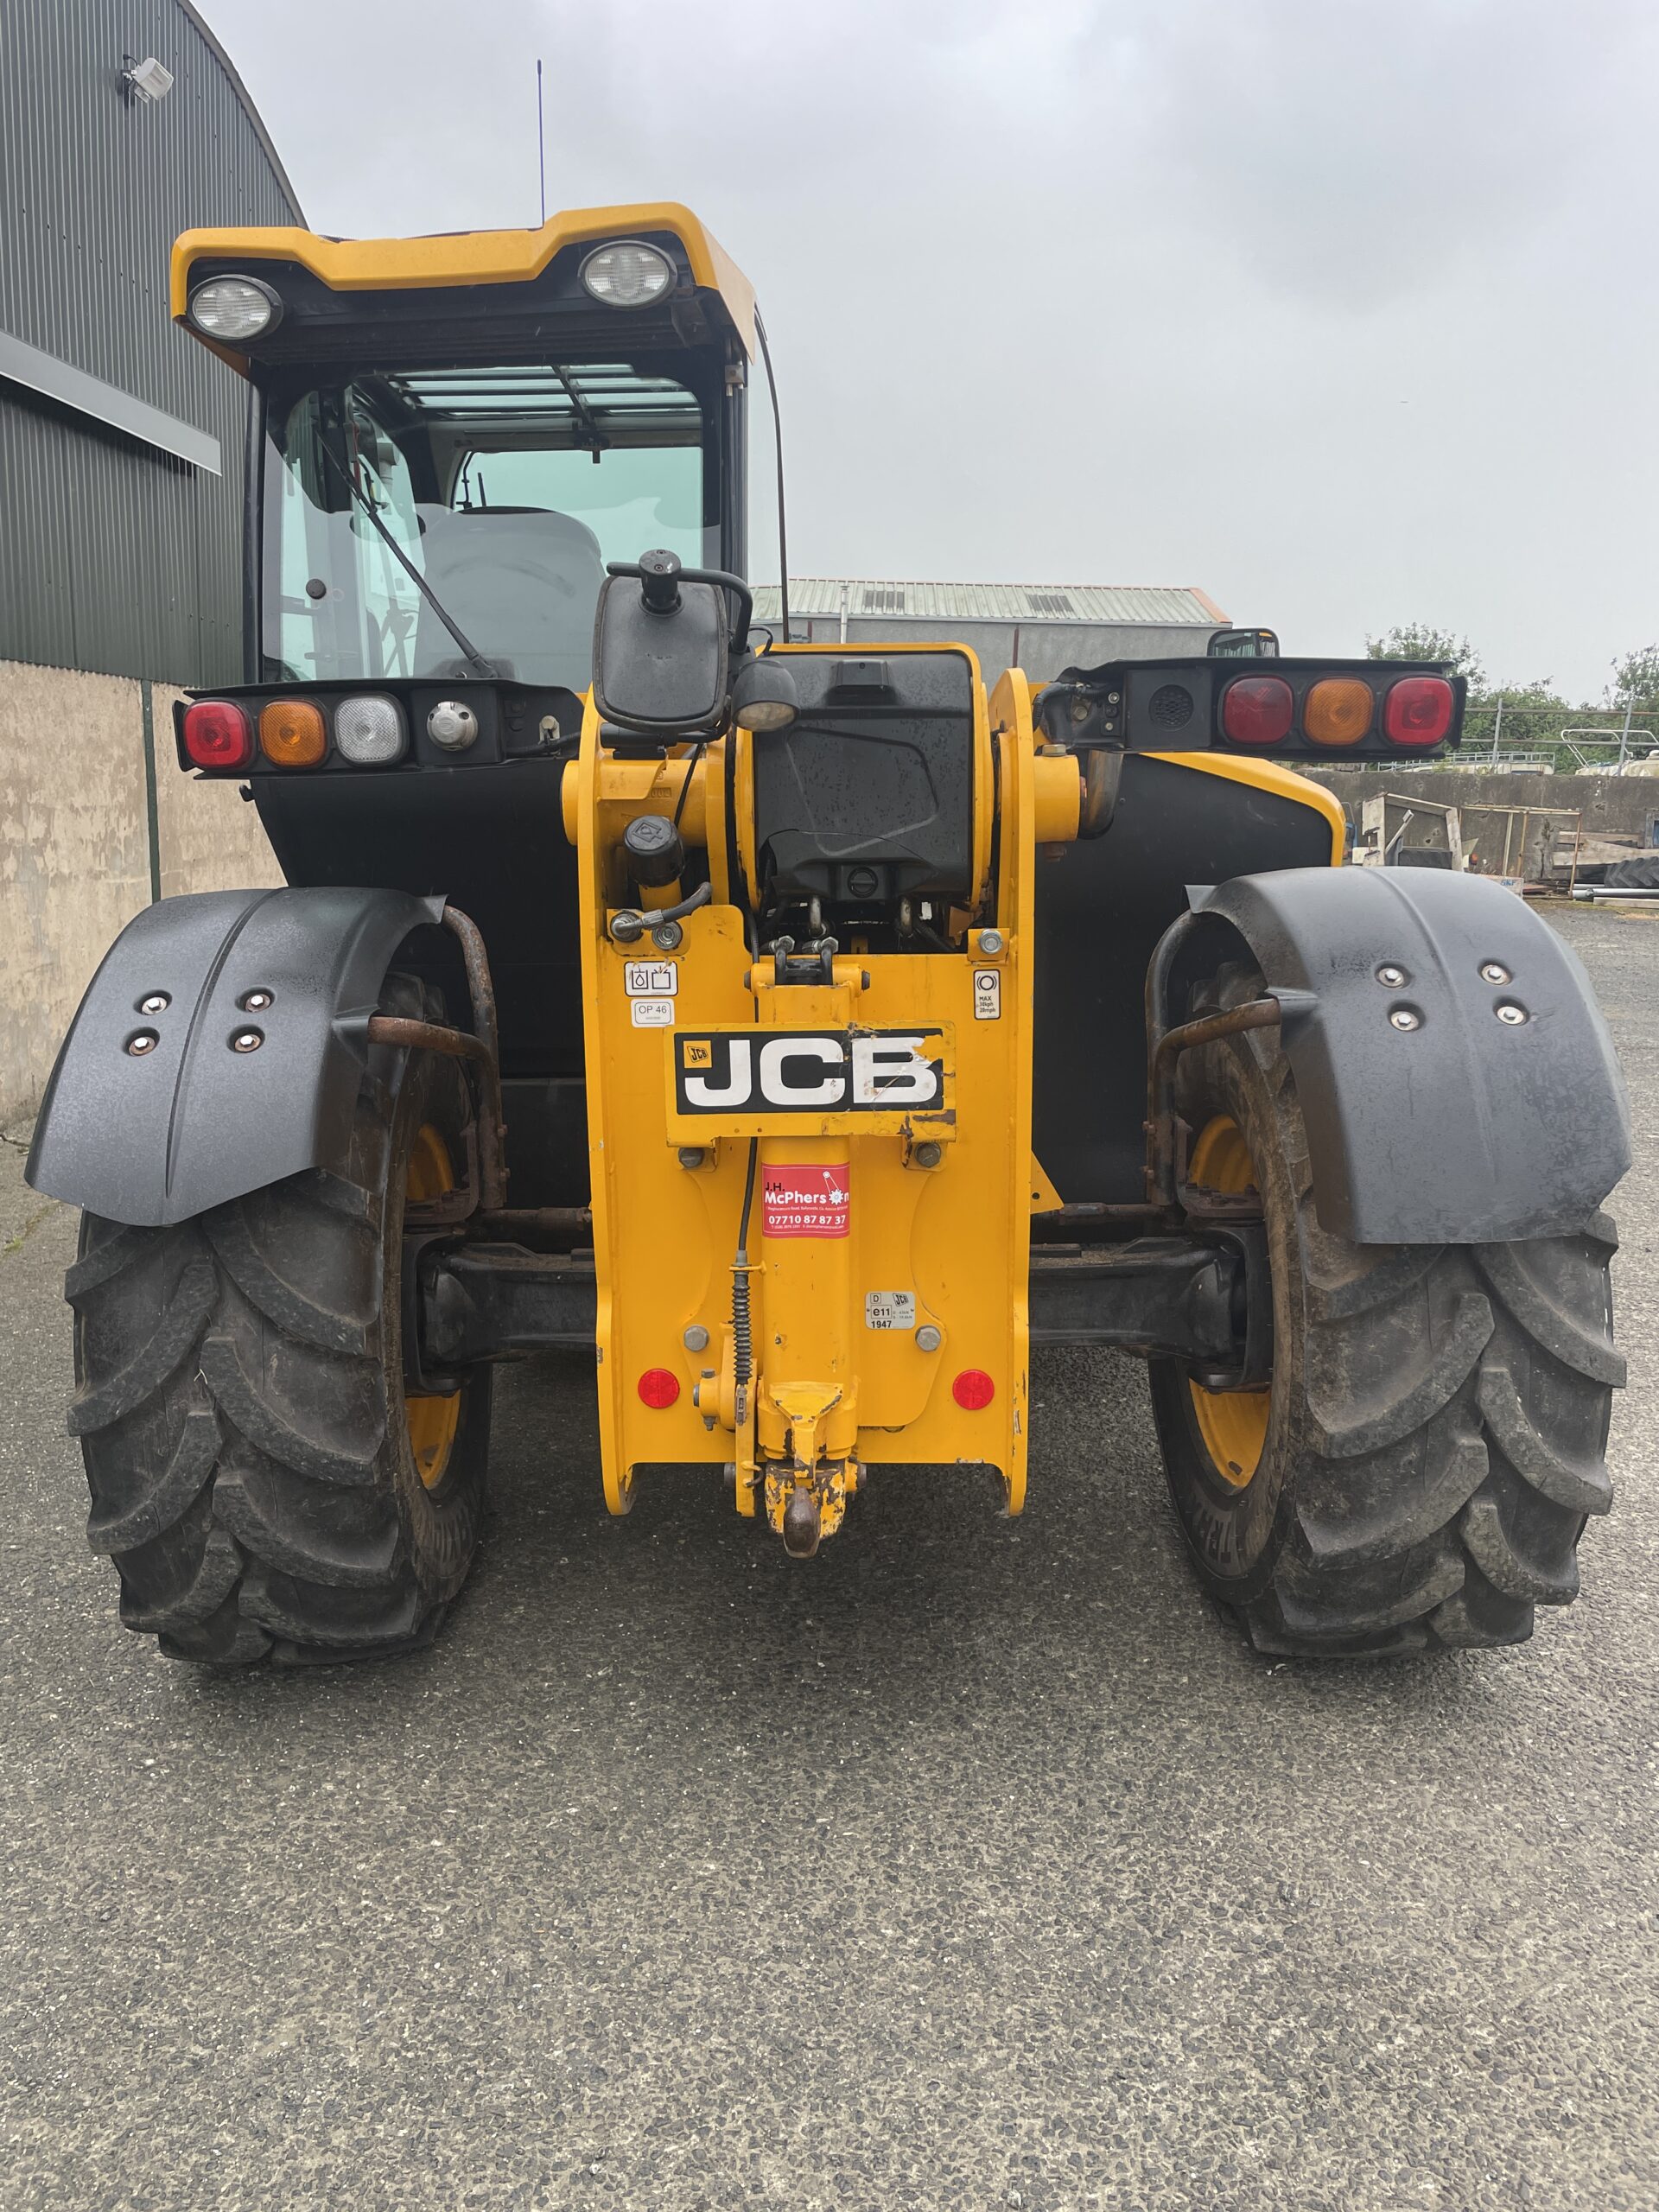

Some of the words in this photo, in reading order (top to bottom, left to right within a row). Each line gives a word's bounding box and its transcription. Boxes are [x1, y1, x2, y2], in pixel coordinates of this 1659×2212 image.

[639, 1005, 652, 1014] OP
[655, 1005, 667, 1014] 46
[690, 1047, 707, 1061] JCB
[684, 1037, 938, 1107] JCB
[765, 1181, 785, 1192] J.H.
[768, 1215, 802, 1225] 07710
[804, 1215, 817, 1224] 87
[819, 1215, 832, 1225] 87
[834, 1214, 846, 1225] 37
[873, 1294, 880, 1303] D
[895, 1294, 908, 1305] JCB
